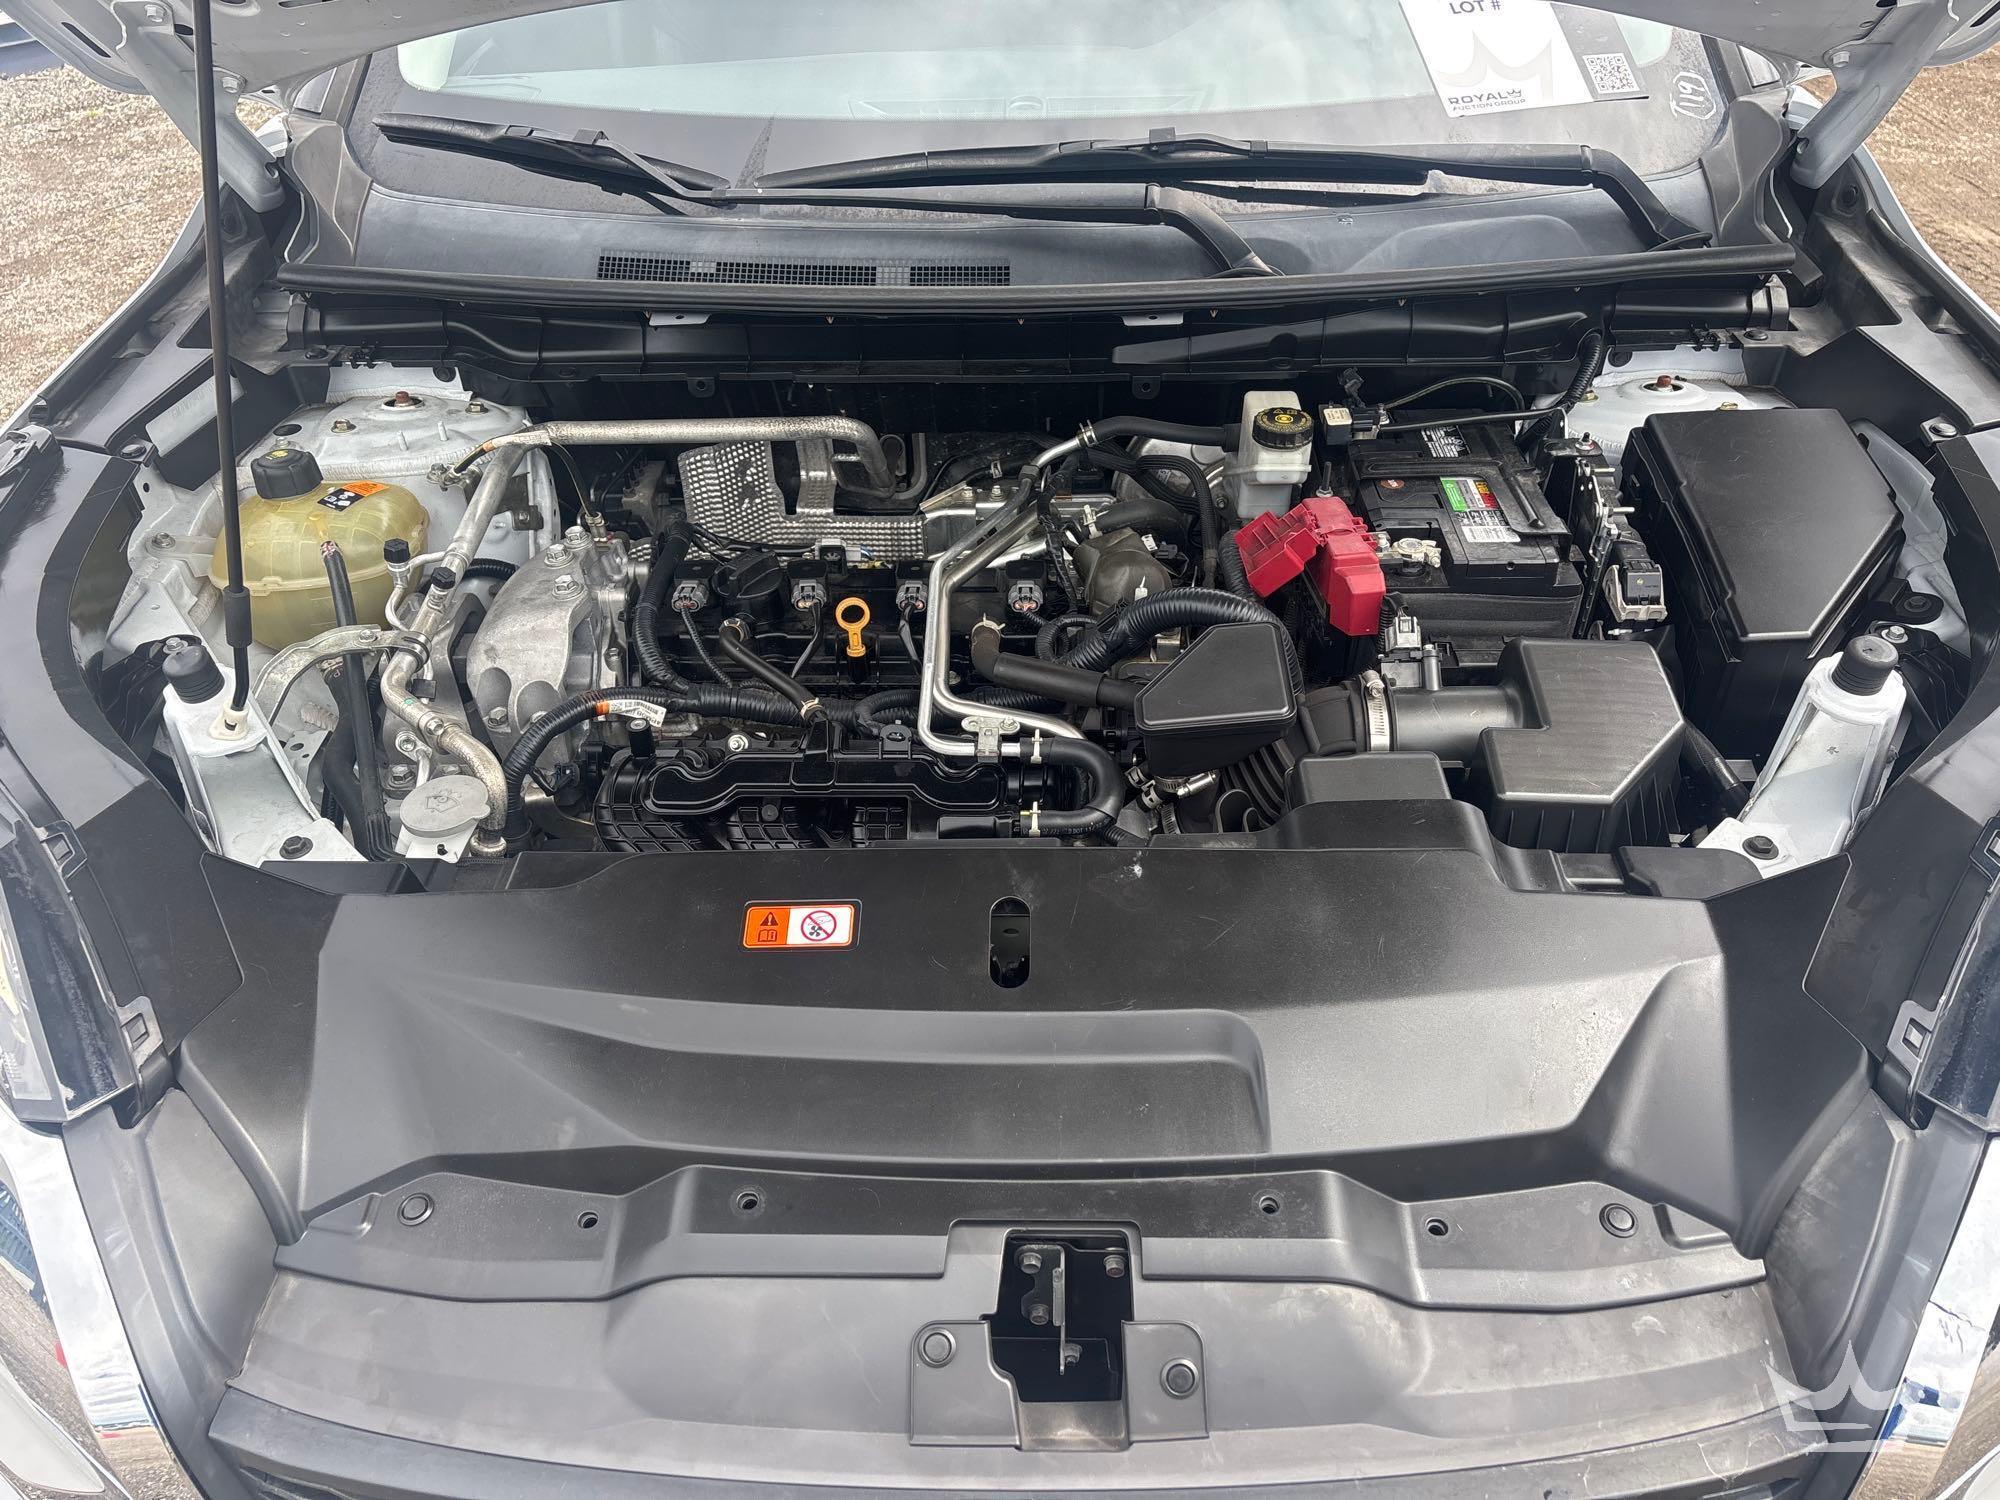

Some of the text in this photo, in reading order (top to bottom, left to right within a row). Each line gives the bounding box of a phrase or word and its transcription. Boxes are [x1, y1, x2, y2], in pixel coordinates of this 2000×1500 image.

[1449, 0, 1502, 15] LOT #
[1448, 92, 1509, 105] ROYAL
[1494, 98, 1527, 107] GROUP
